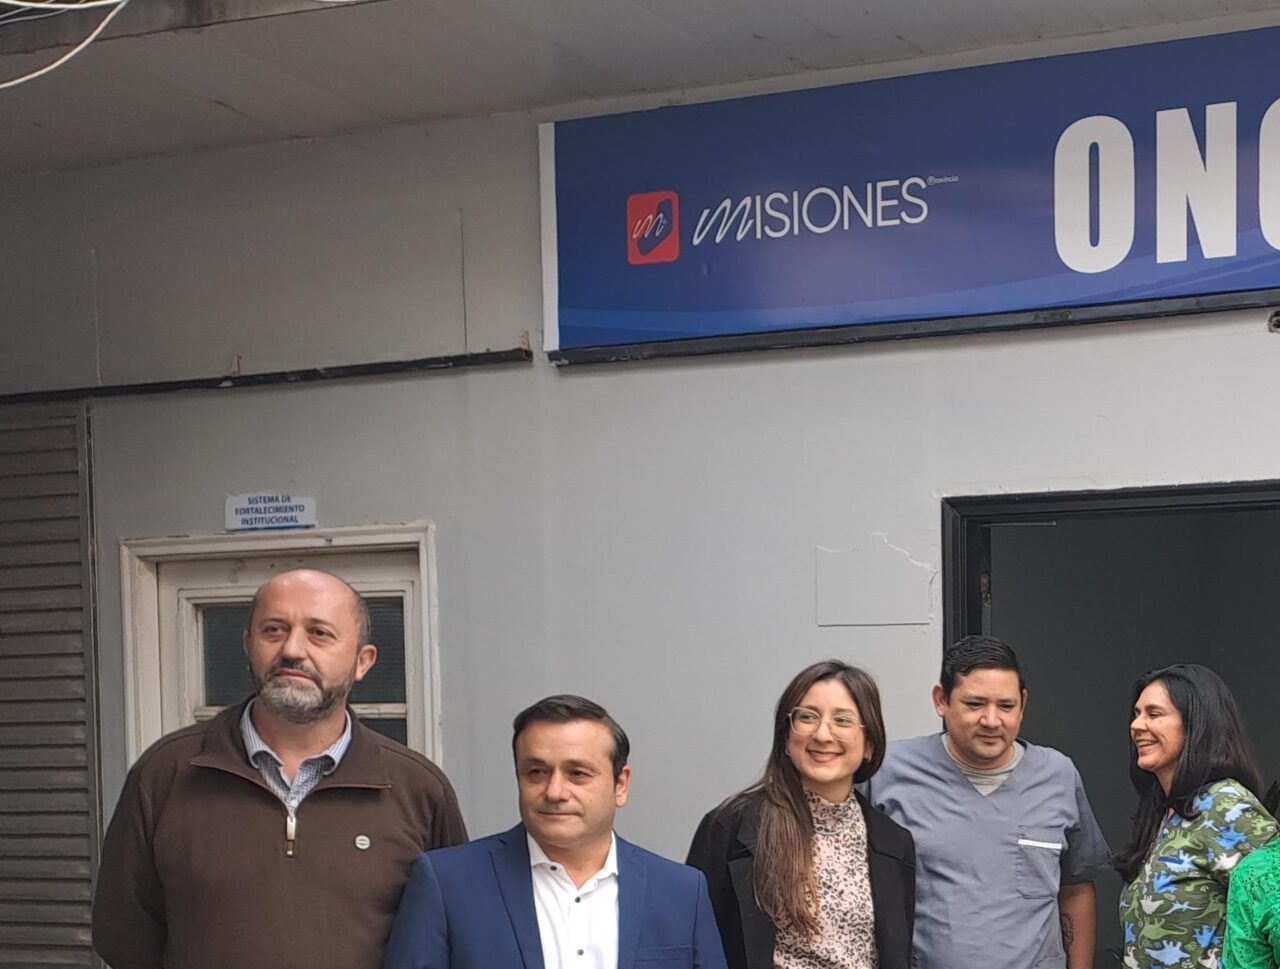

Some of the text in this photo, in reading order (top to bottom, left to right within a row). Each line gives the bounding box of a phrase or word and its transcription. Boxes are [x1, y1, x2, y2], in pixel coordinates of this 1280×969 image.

[247, 495, 291, 505] SISTEMA DE
[235, 504, 305, 515] FORTALECIMIENTO
[241, 515, 299, 525] INSTITUCIONAL
